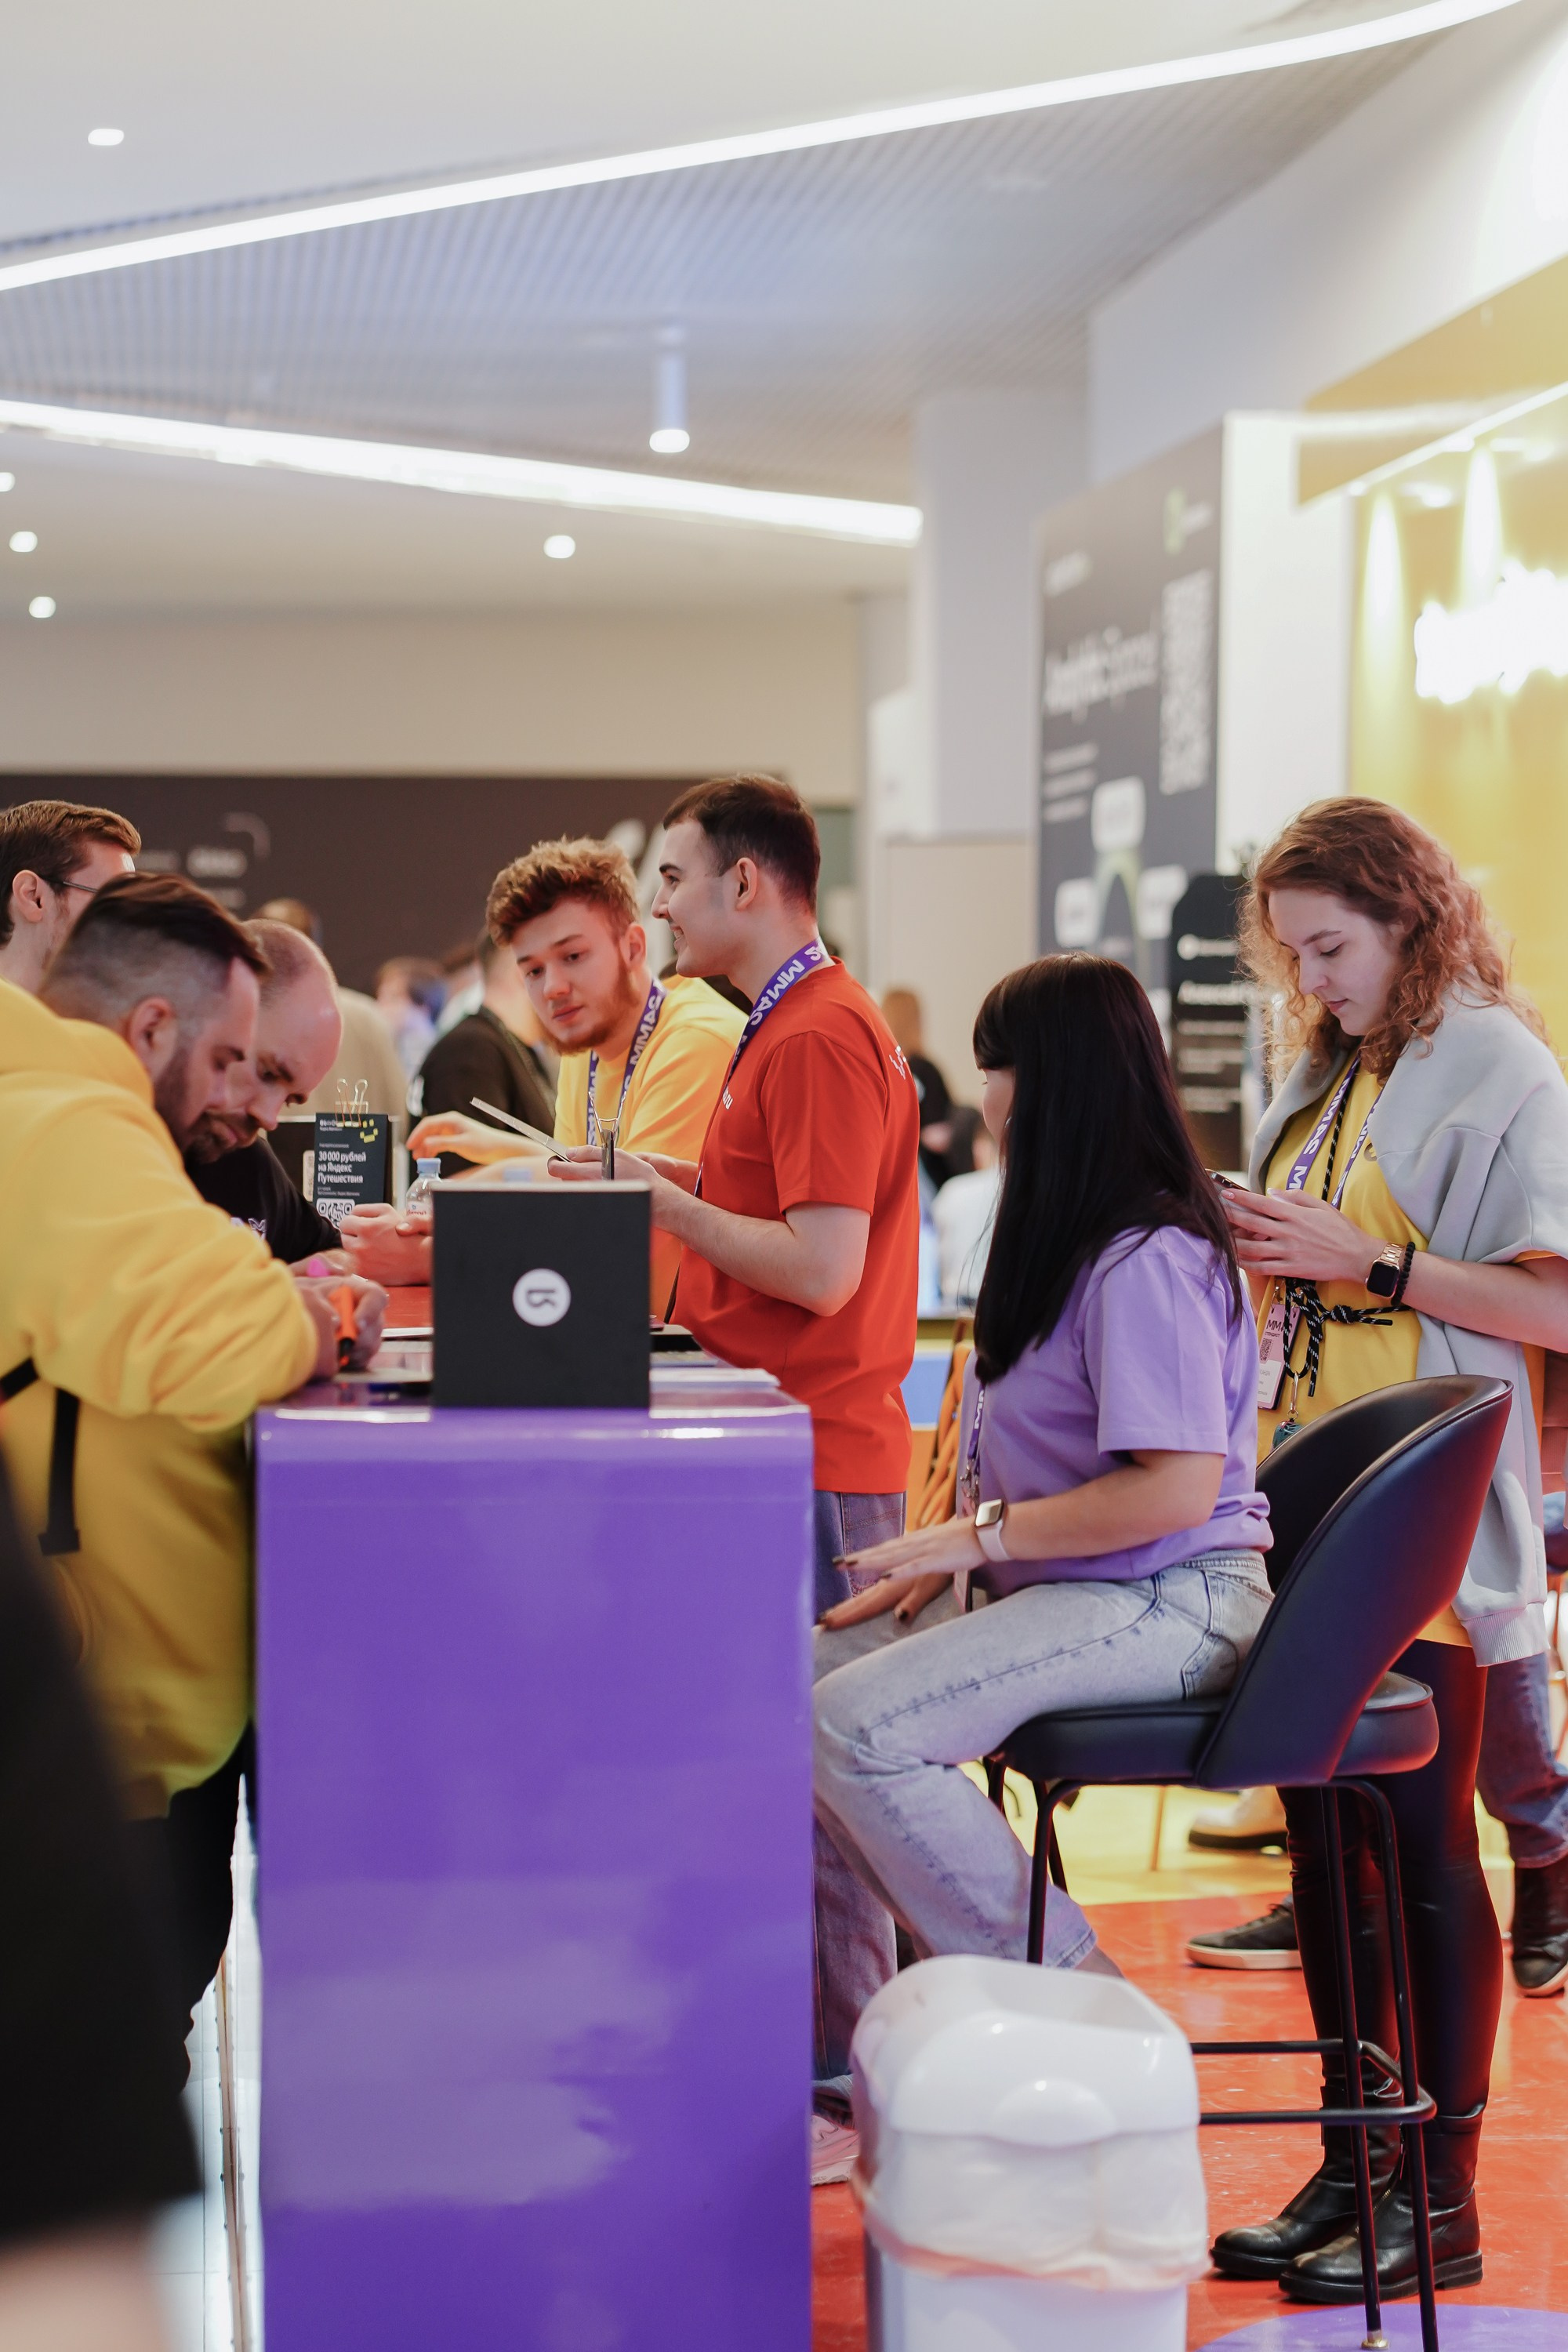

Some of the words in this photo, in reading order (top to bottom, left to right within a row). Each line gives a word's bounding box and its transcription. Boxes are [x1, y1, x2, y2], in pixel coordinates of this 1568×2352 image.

[318, 1151, 327, 1161] 30
[327, 1150, 340, 1161] 000
[340, 1151, 366, 1163] рублей
[318, 1163, 326, 1172] на
[327, 1162, 352, 1173] Яндекс
[318, 1172, 363, 1185] Путешествия
